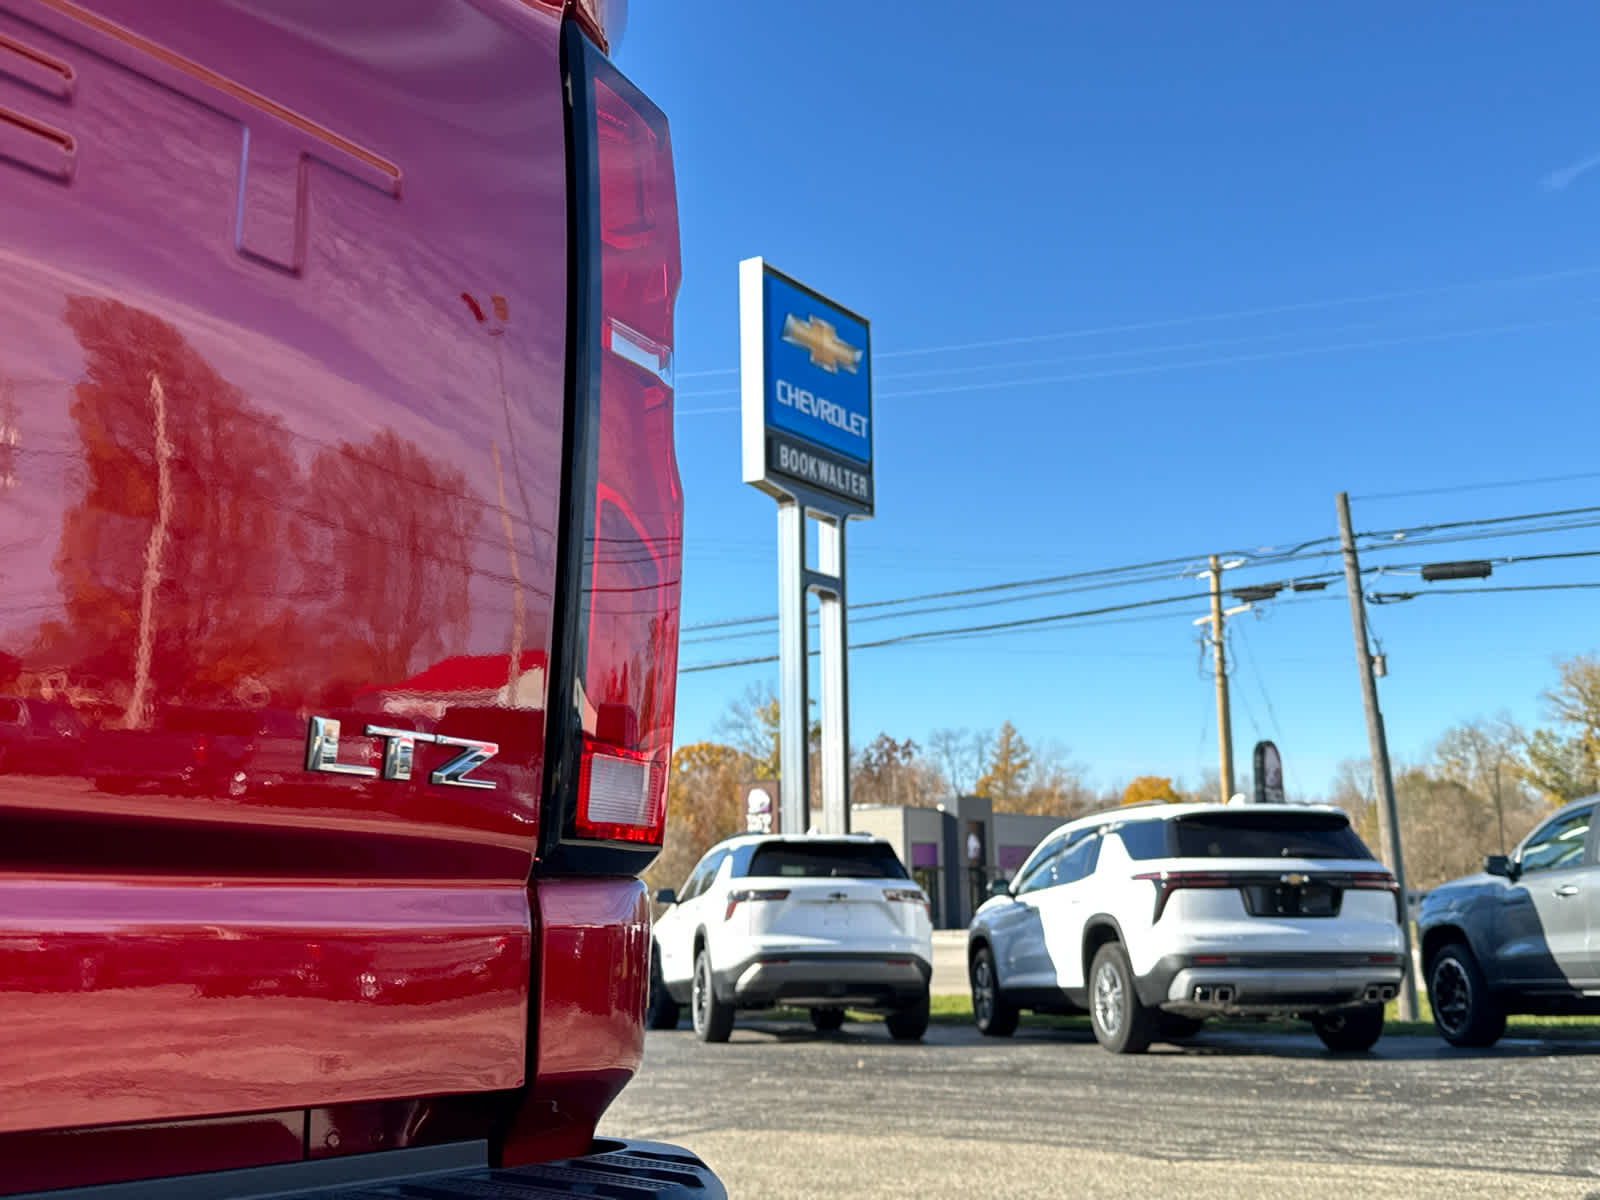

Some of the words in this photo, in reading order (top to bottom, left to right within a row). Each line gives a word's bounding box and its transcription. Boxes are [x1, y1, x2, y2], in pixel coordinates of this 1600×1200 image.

[776, 379, 868, 438] CHEVROLET
[779, 445, 868, 497] BOOKWALTER
[306, 715, 499, 789] LTZ
